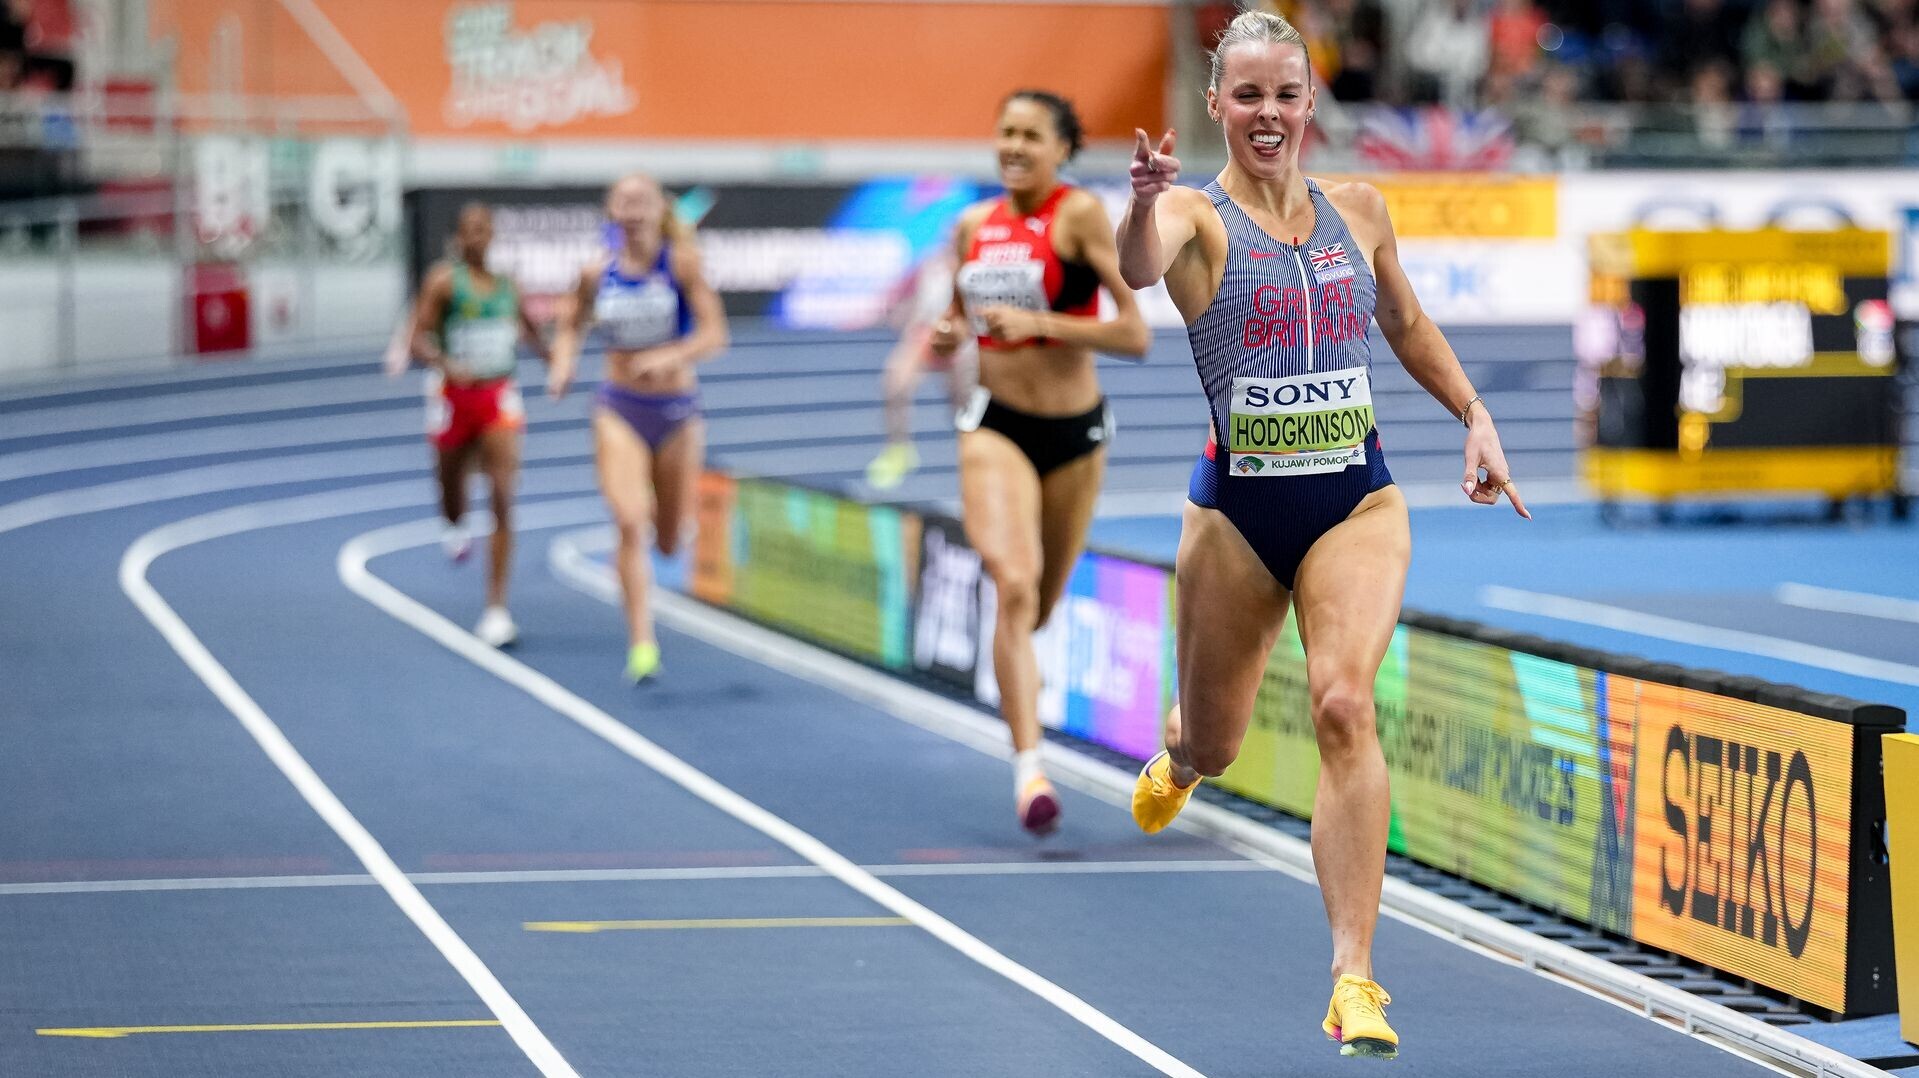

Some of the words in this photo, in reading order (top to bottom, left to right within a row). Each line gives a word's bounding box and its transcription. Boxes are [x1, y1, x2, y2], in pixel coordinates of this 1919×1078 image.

[1253, 278, 1354, 317] GREAT
[1243, 312, 1368, 349] BRITAIN
[1245, 377, 1356, 408] SONY
[1236, 408, 1369, 447] HODGKINSON
[1271, 458, 1312, 469] KUJAWY
[1313, 455, 1349, 467] POMOR
[1660, 723, 1817, 960] SEIKO
